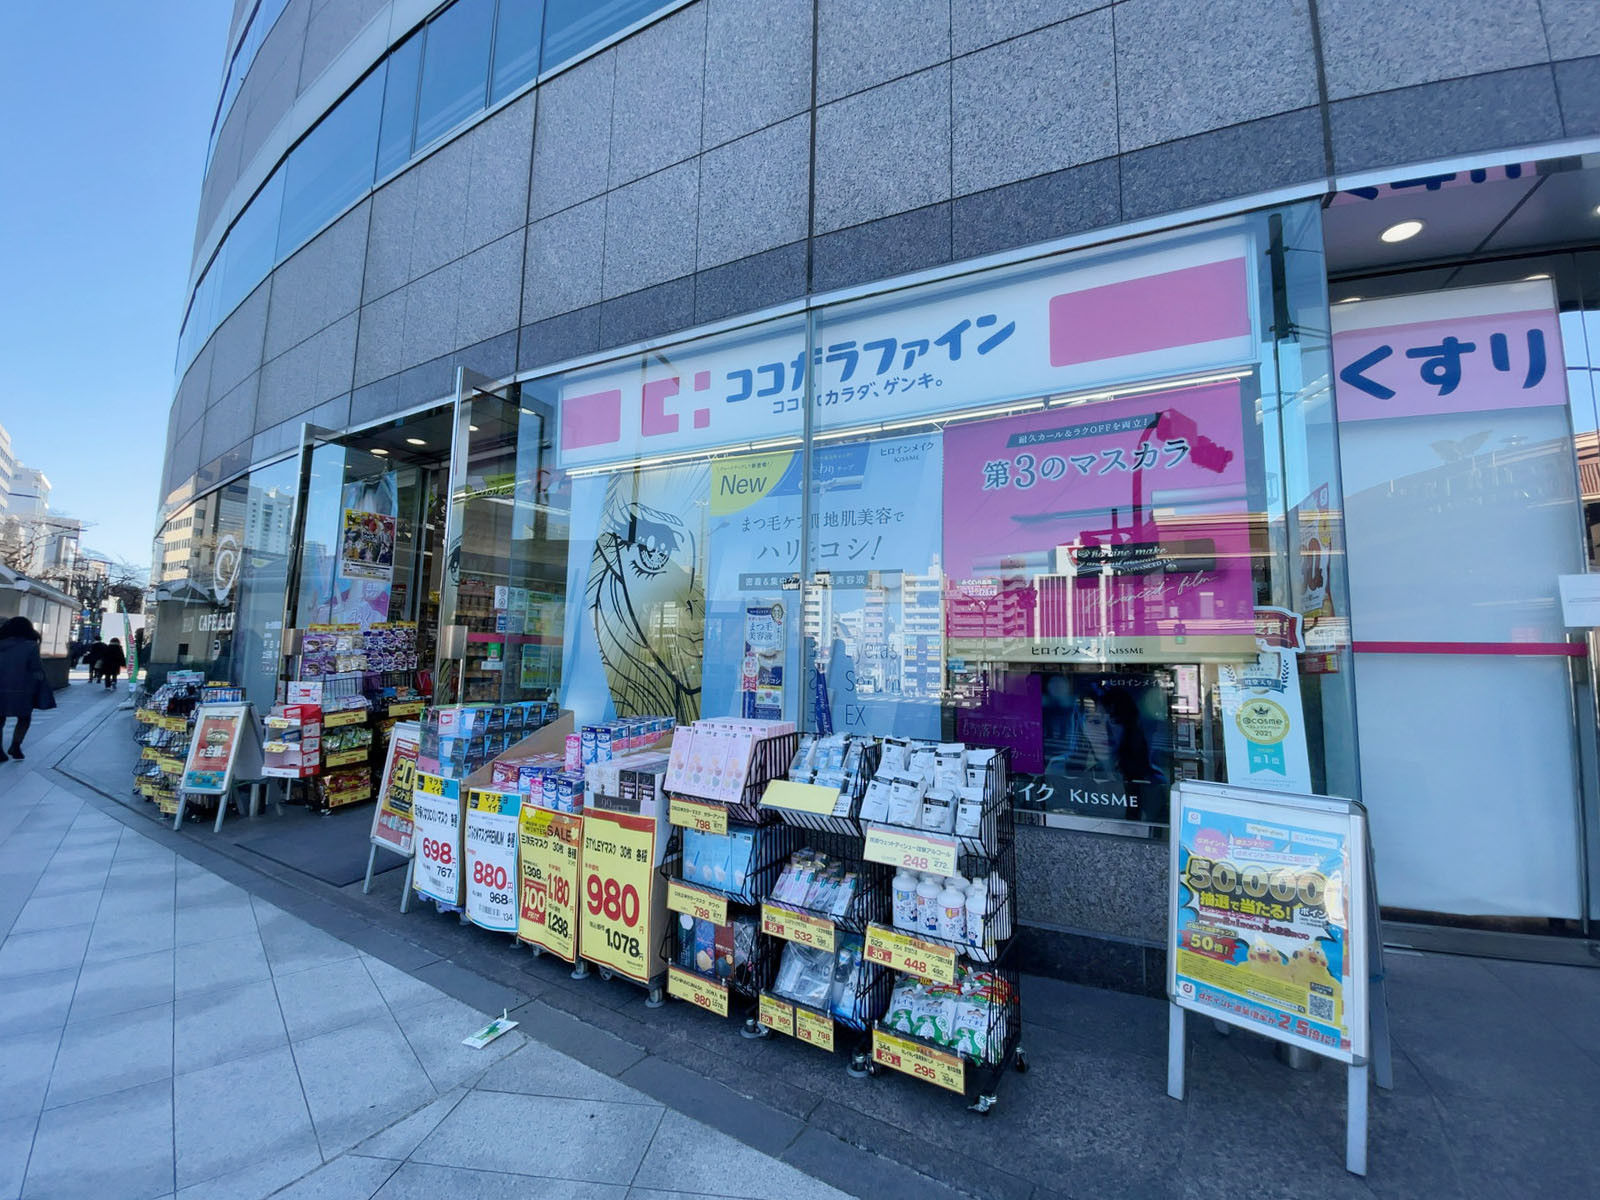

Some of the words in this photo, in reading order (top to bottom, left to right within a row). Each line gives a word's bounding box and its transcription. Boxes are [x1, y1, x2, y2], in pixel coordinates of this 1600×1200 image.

[725, 313, 1017, 404] ココカラファイン
[1339, 328, 1548, 401] くすり
[772, 371, 944, 415] ココカラダ、ゲンキ。
[880, 441, 935, 457] ヒロインメイク
[982, 437, 1191, 491] 第3のマスカラ
[719, 474, 768, 496] New
[1110, 676, 1168, 688] ヒロインメイ
[845, 704, 866, 727] EX
[1242, 716, 1284, 727] @cosme
[1254, 730, 1273, 738] 2021
[1017, 785, 1055, 803] イク
[1069, 788, 1139, 808] KISSME
[546, 823, 573, 844] SALE
[695, 818, 711, 830] 798
[422, 836, 452, 865] 698
[902, 853, 929, 870] 248
[436, 865, 453, 879] 767
[473, 859, 508, 891] 880
[1188, 858, 1328, 906] 50,000
[488, 890, 509, 906] 968
[524, 885, 546, 914] 100
[586, 873, 641, 928] 980
[1199, 890, 1292, 920] 抽選で当たる!
[1299, 907, 1329, 919] ポイン
[693, 905, 710, 919] 798
[604, 927, 641, 958] 1,078
[794, 929, 813, 943] 532
[872, 949, 884, 960] 30
[903, 957, 927, 973] 448
[694, 992, 712, 1008] 980
[913, 1063, 937, 1080] 295
